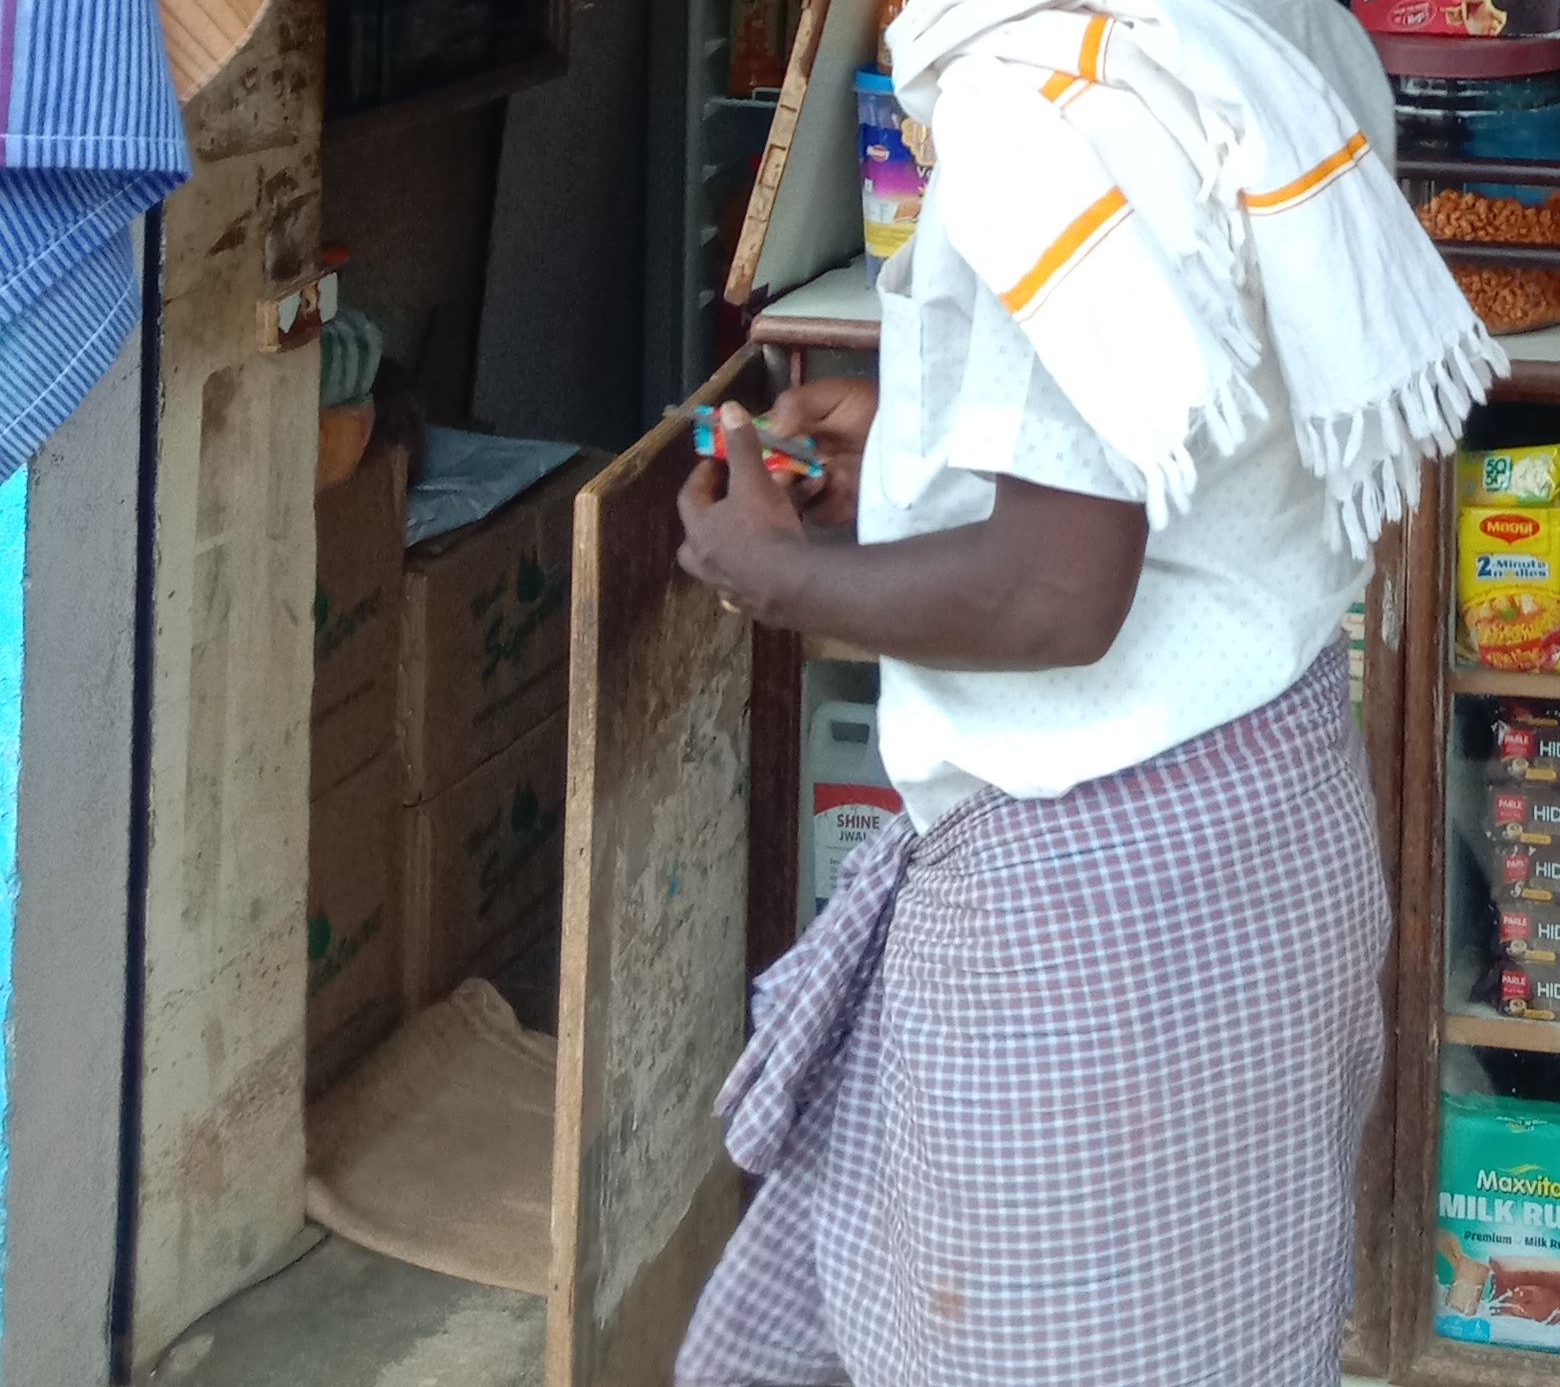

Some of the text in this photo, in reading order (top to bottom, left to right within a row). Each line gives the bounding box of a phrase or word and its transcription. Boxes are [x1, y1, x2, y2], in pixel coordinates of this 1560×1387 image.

[1485, 521, 1534, 536] Maggi
[1439, 1190, 1515, 1224] MILK
[1464, 1230, 1512, 1246] Premium
[1524, 1235, 1548, 1248] Milk
